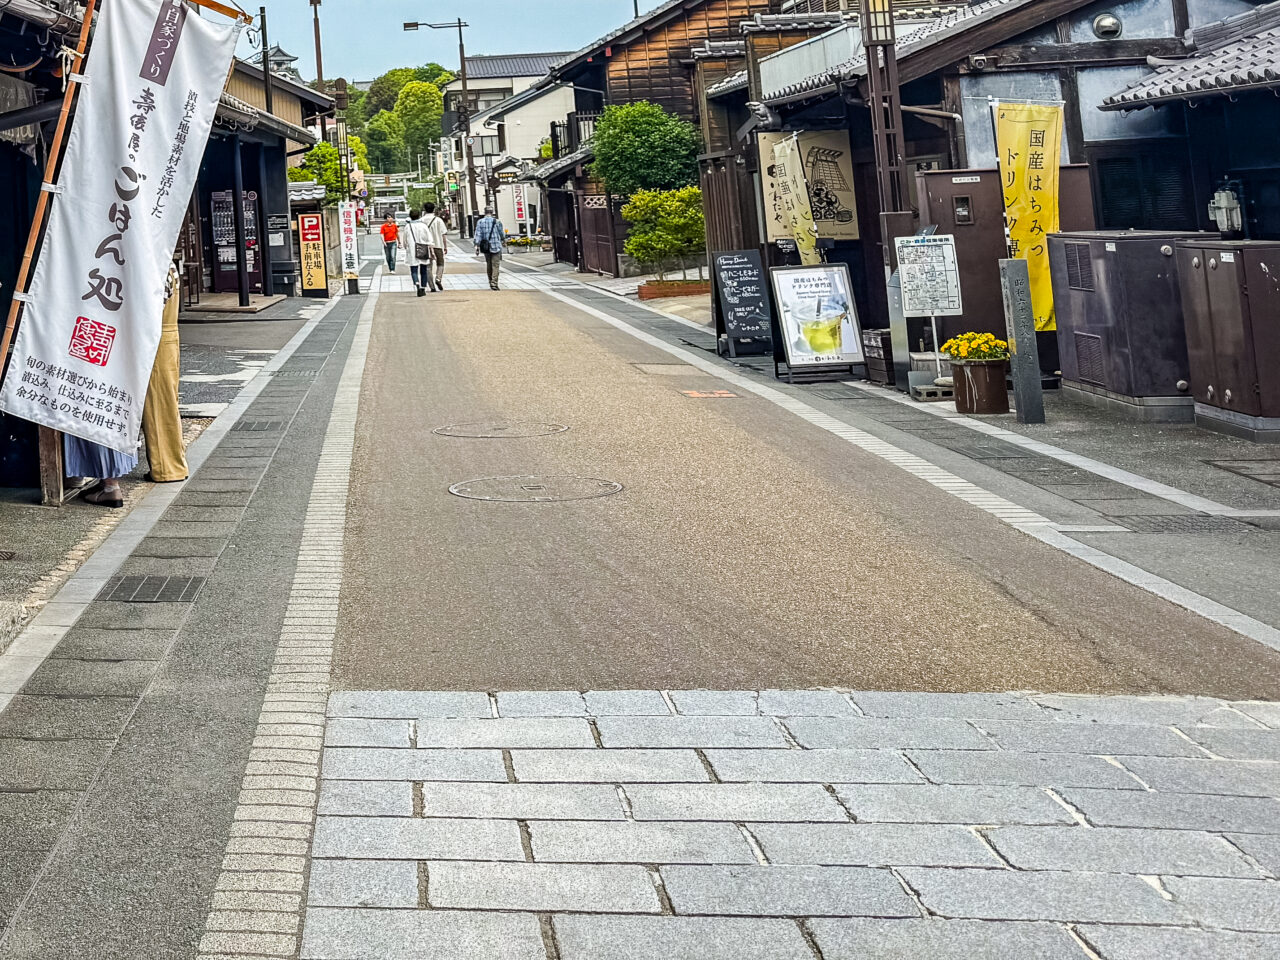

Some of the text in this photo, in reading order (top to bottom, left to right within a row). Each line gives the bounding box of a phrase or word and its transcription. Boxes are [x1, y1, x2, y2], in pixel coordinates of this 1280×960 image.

[150, 8, 180, 78] 自家づくり
[151, 89, 198, 219] 漬技と地場素材を活かした
[1027, 129, 1045, 257] 国産はちみつ
[304, 217, 318, 229] P
[345, 252, 356, 269] 注意
[26, 355, 133, 406] 旬の素材選びから始まり
[16, 385, 129, 438] 余分なものを使用せず。
